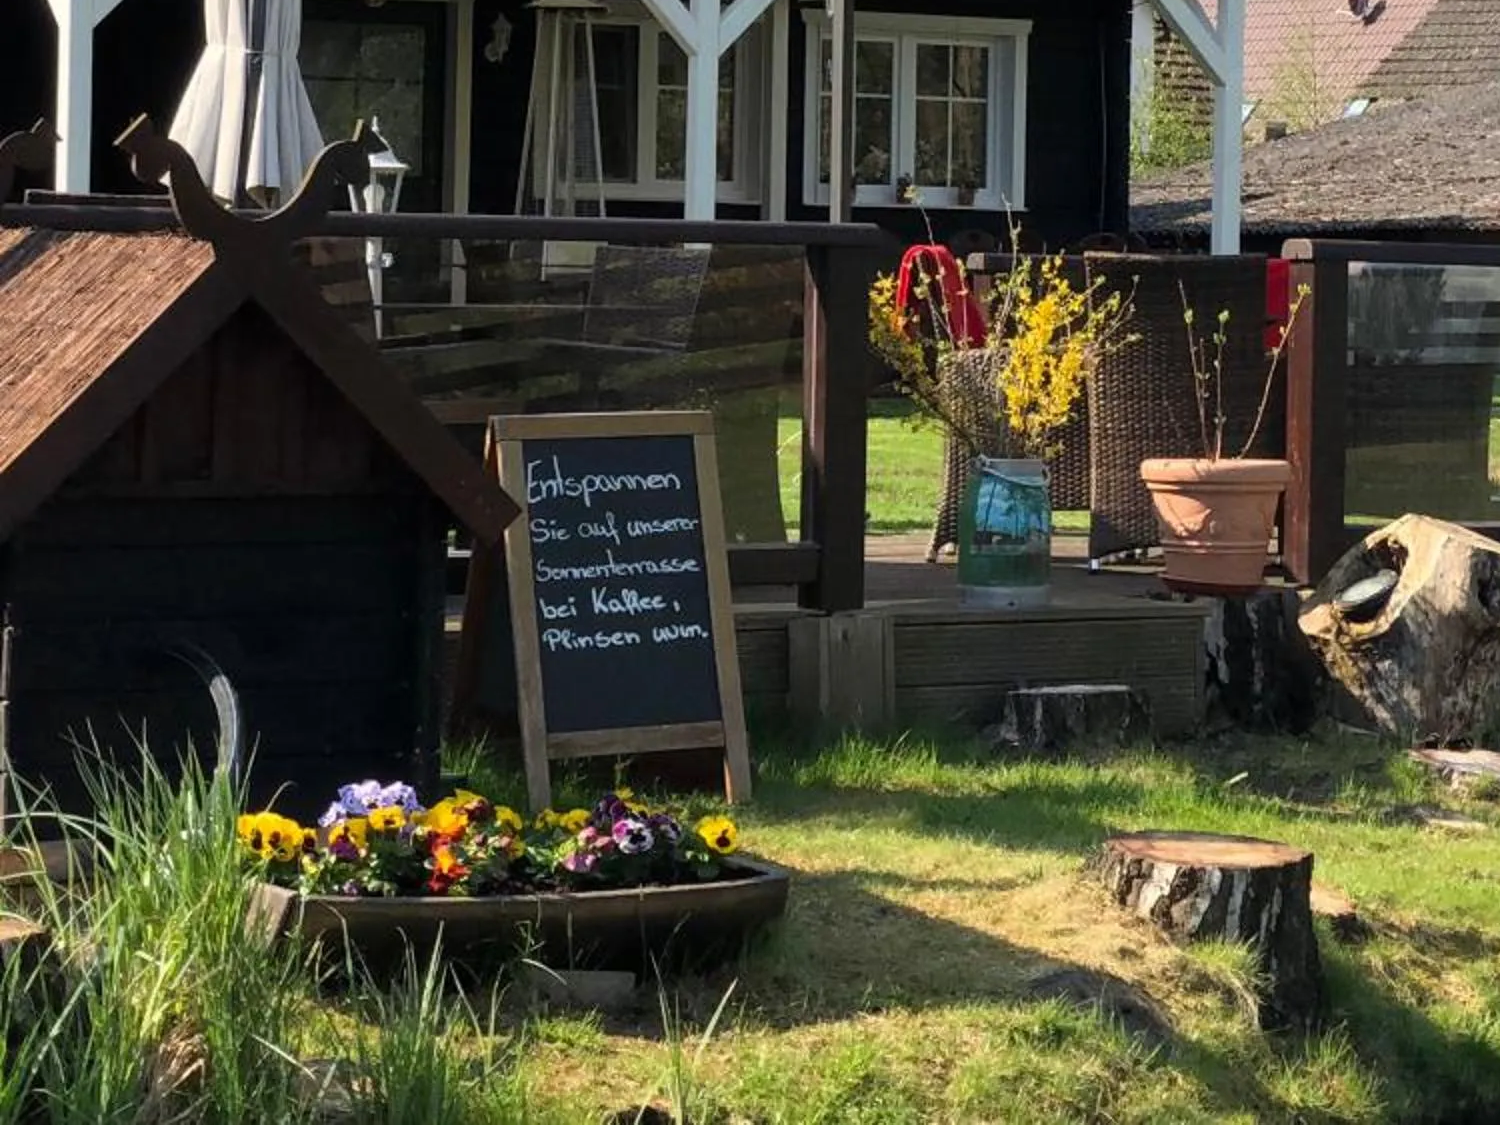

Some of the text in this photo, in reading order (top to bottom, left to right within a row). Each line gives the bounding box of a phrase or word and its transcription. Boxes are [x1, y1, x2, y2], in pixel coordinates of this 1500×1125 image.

[527, 455, 681, 507] Entspannen
[530, 511, 699, 546] Sie auf unserer
[536, 548, 701, 583] Sonnenterrasse
[540, 596, 577, 620] bei
[542, 628, 641, 652] Plinsen
